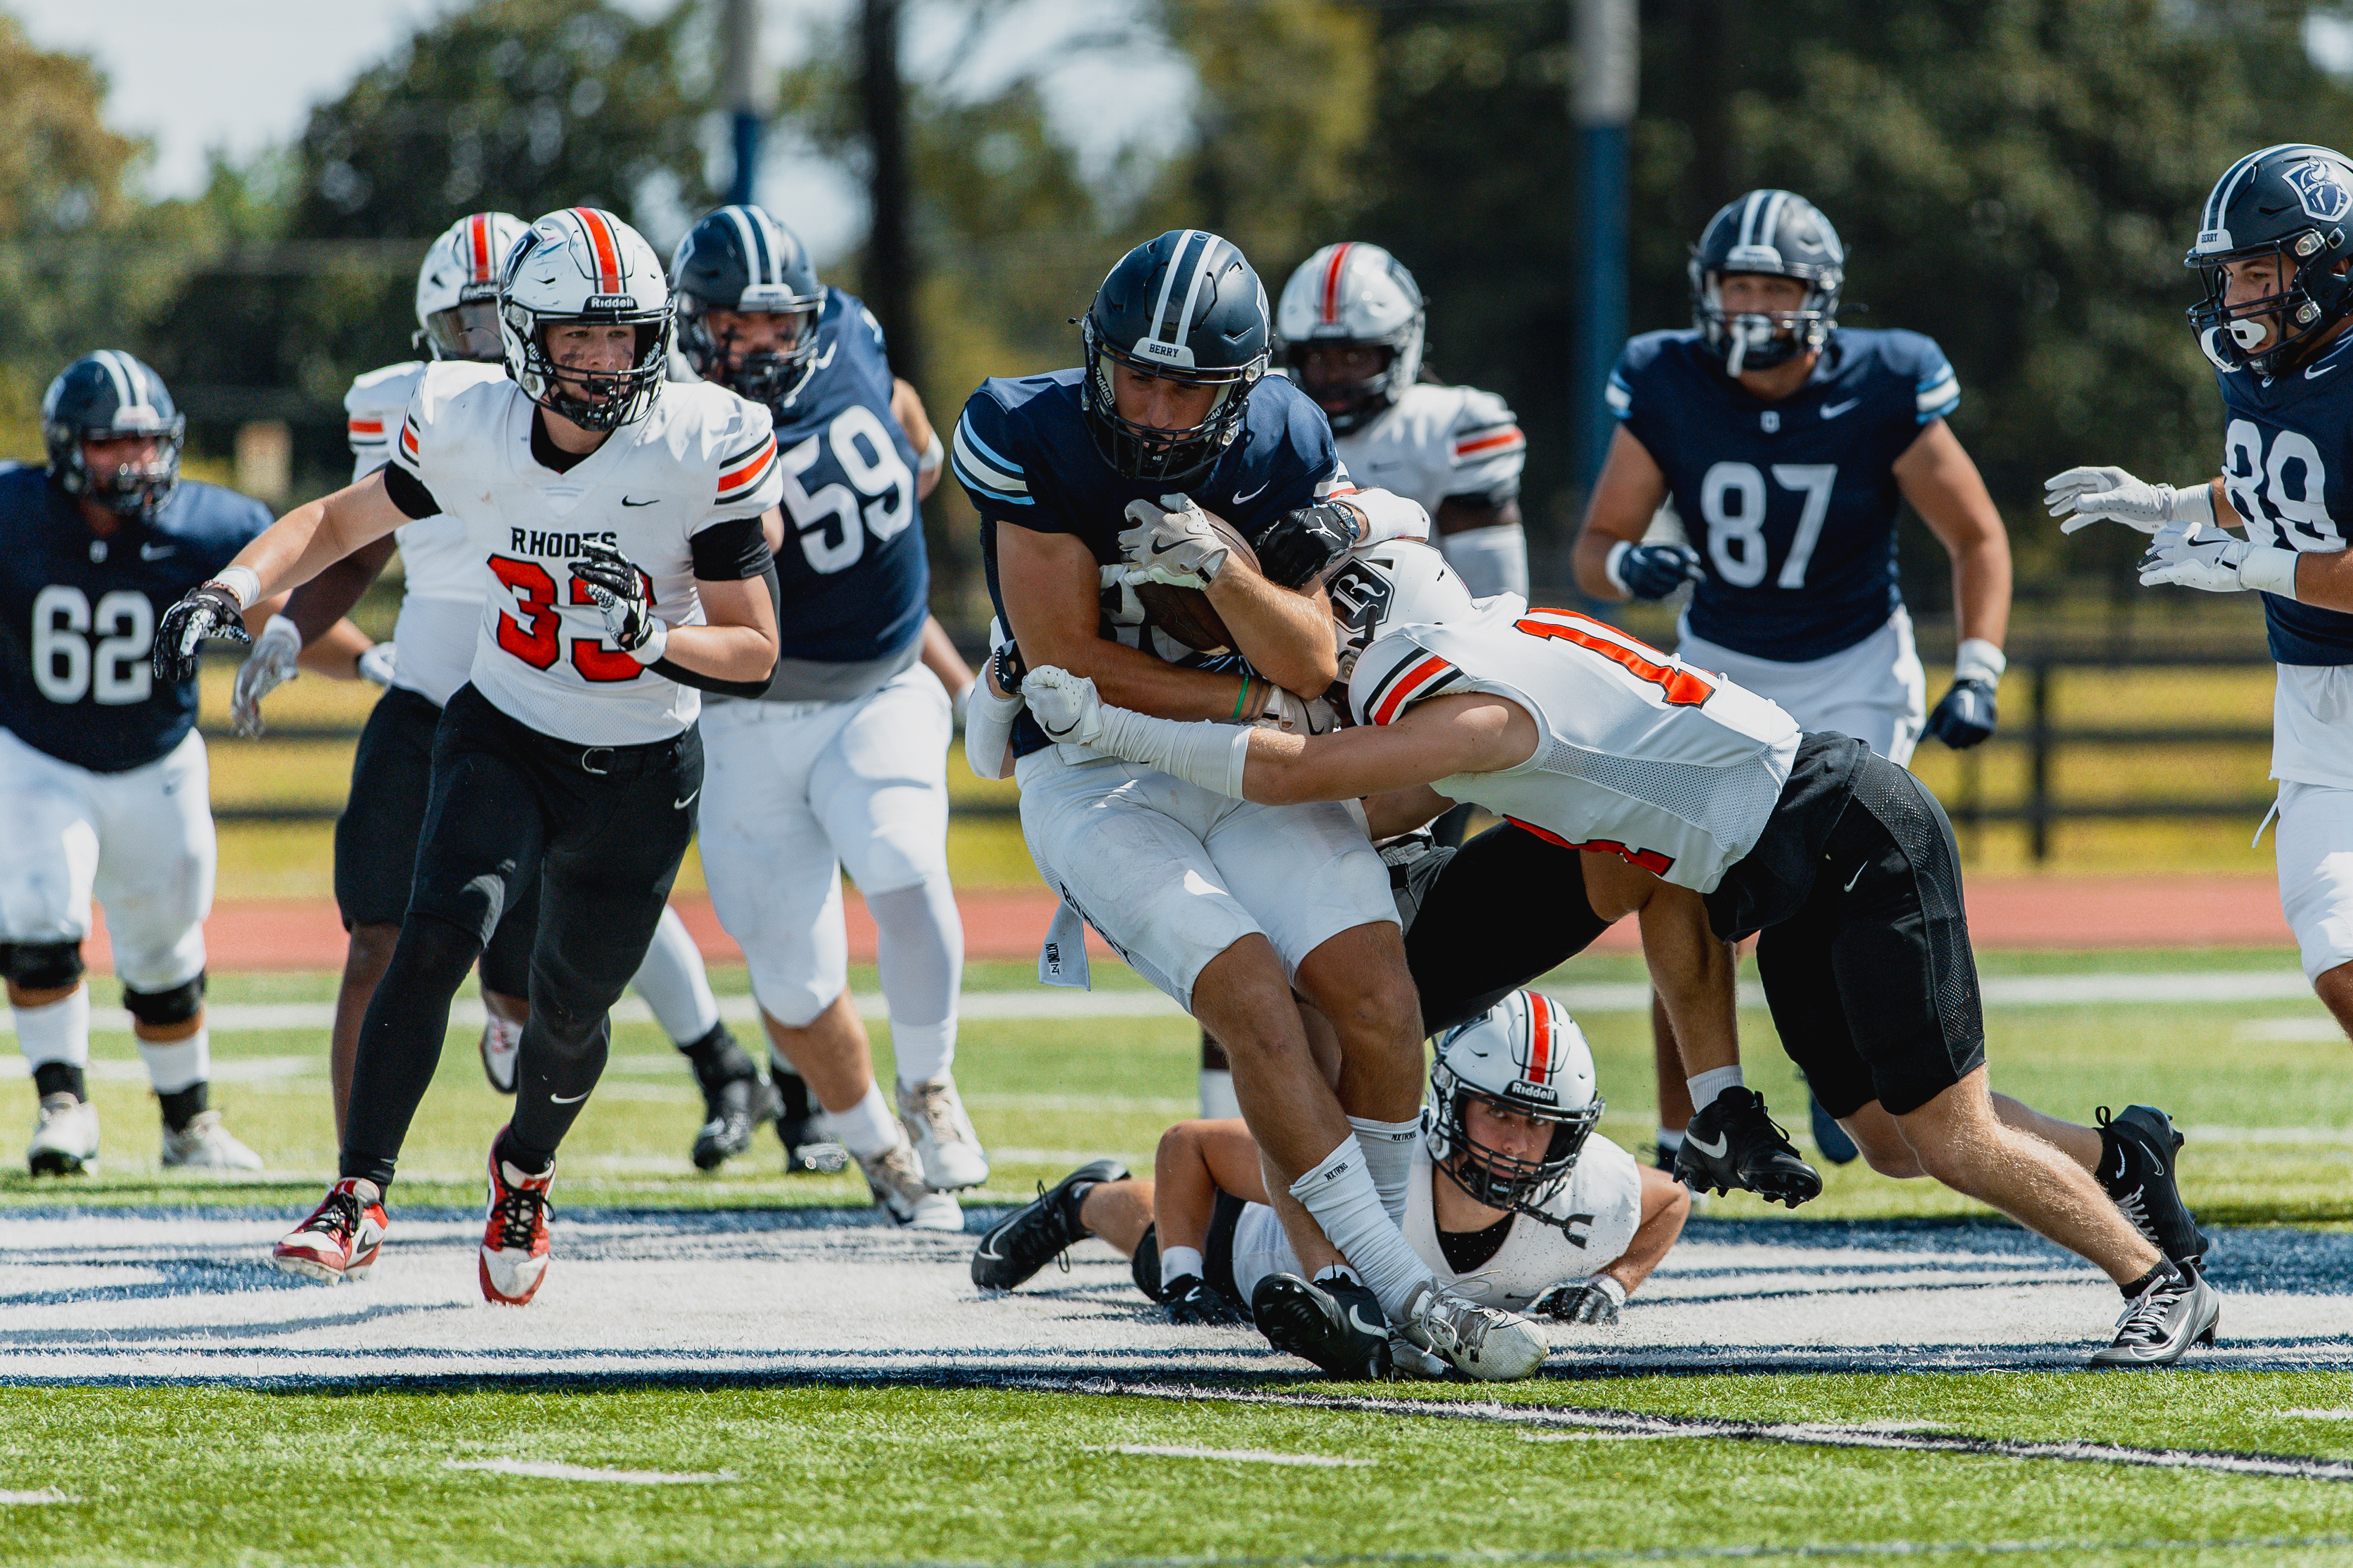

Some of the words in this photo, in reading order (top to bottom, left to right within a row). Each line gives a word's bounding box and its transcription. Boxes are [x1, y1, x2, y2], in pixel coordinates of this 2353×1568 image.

[2201, 233, 2218, 243] BERRY
[591, 297, 634, 309] Riddell
[1149, 343, 1179, 357] BERRY
[780, 405, 914, 574] 59
[2221, 418, 2347, 554] 89
[1700, 460, 1838, 589] 87
[1330, 574, 1385, 619] R
[32, 584, 155, 705] 62
[1511, 1081, 1556, 1101] Riddell
